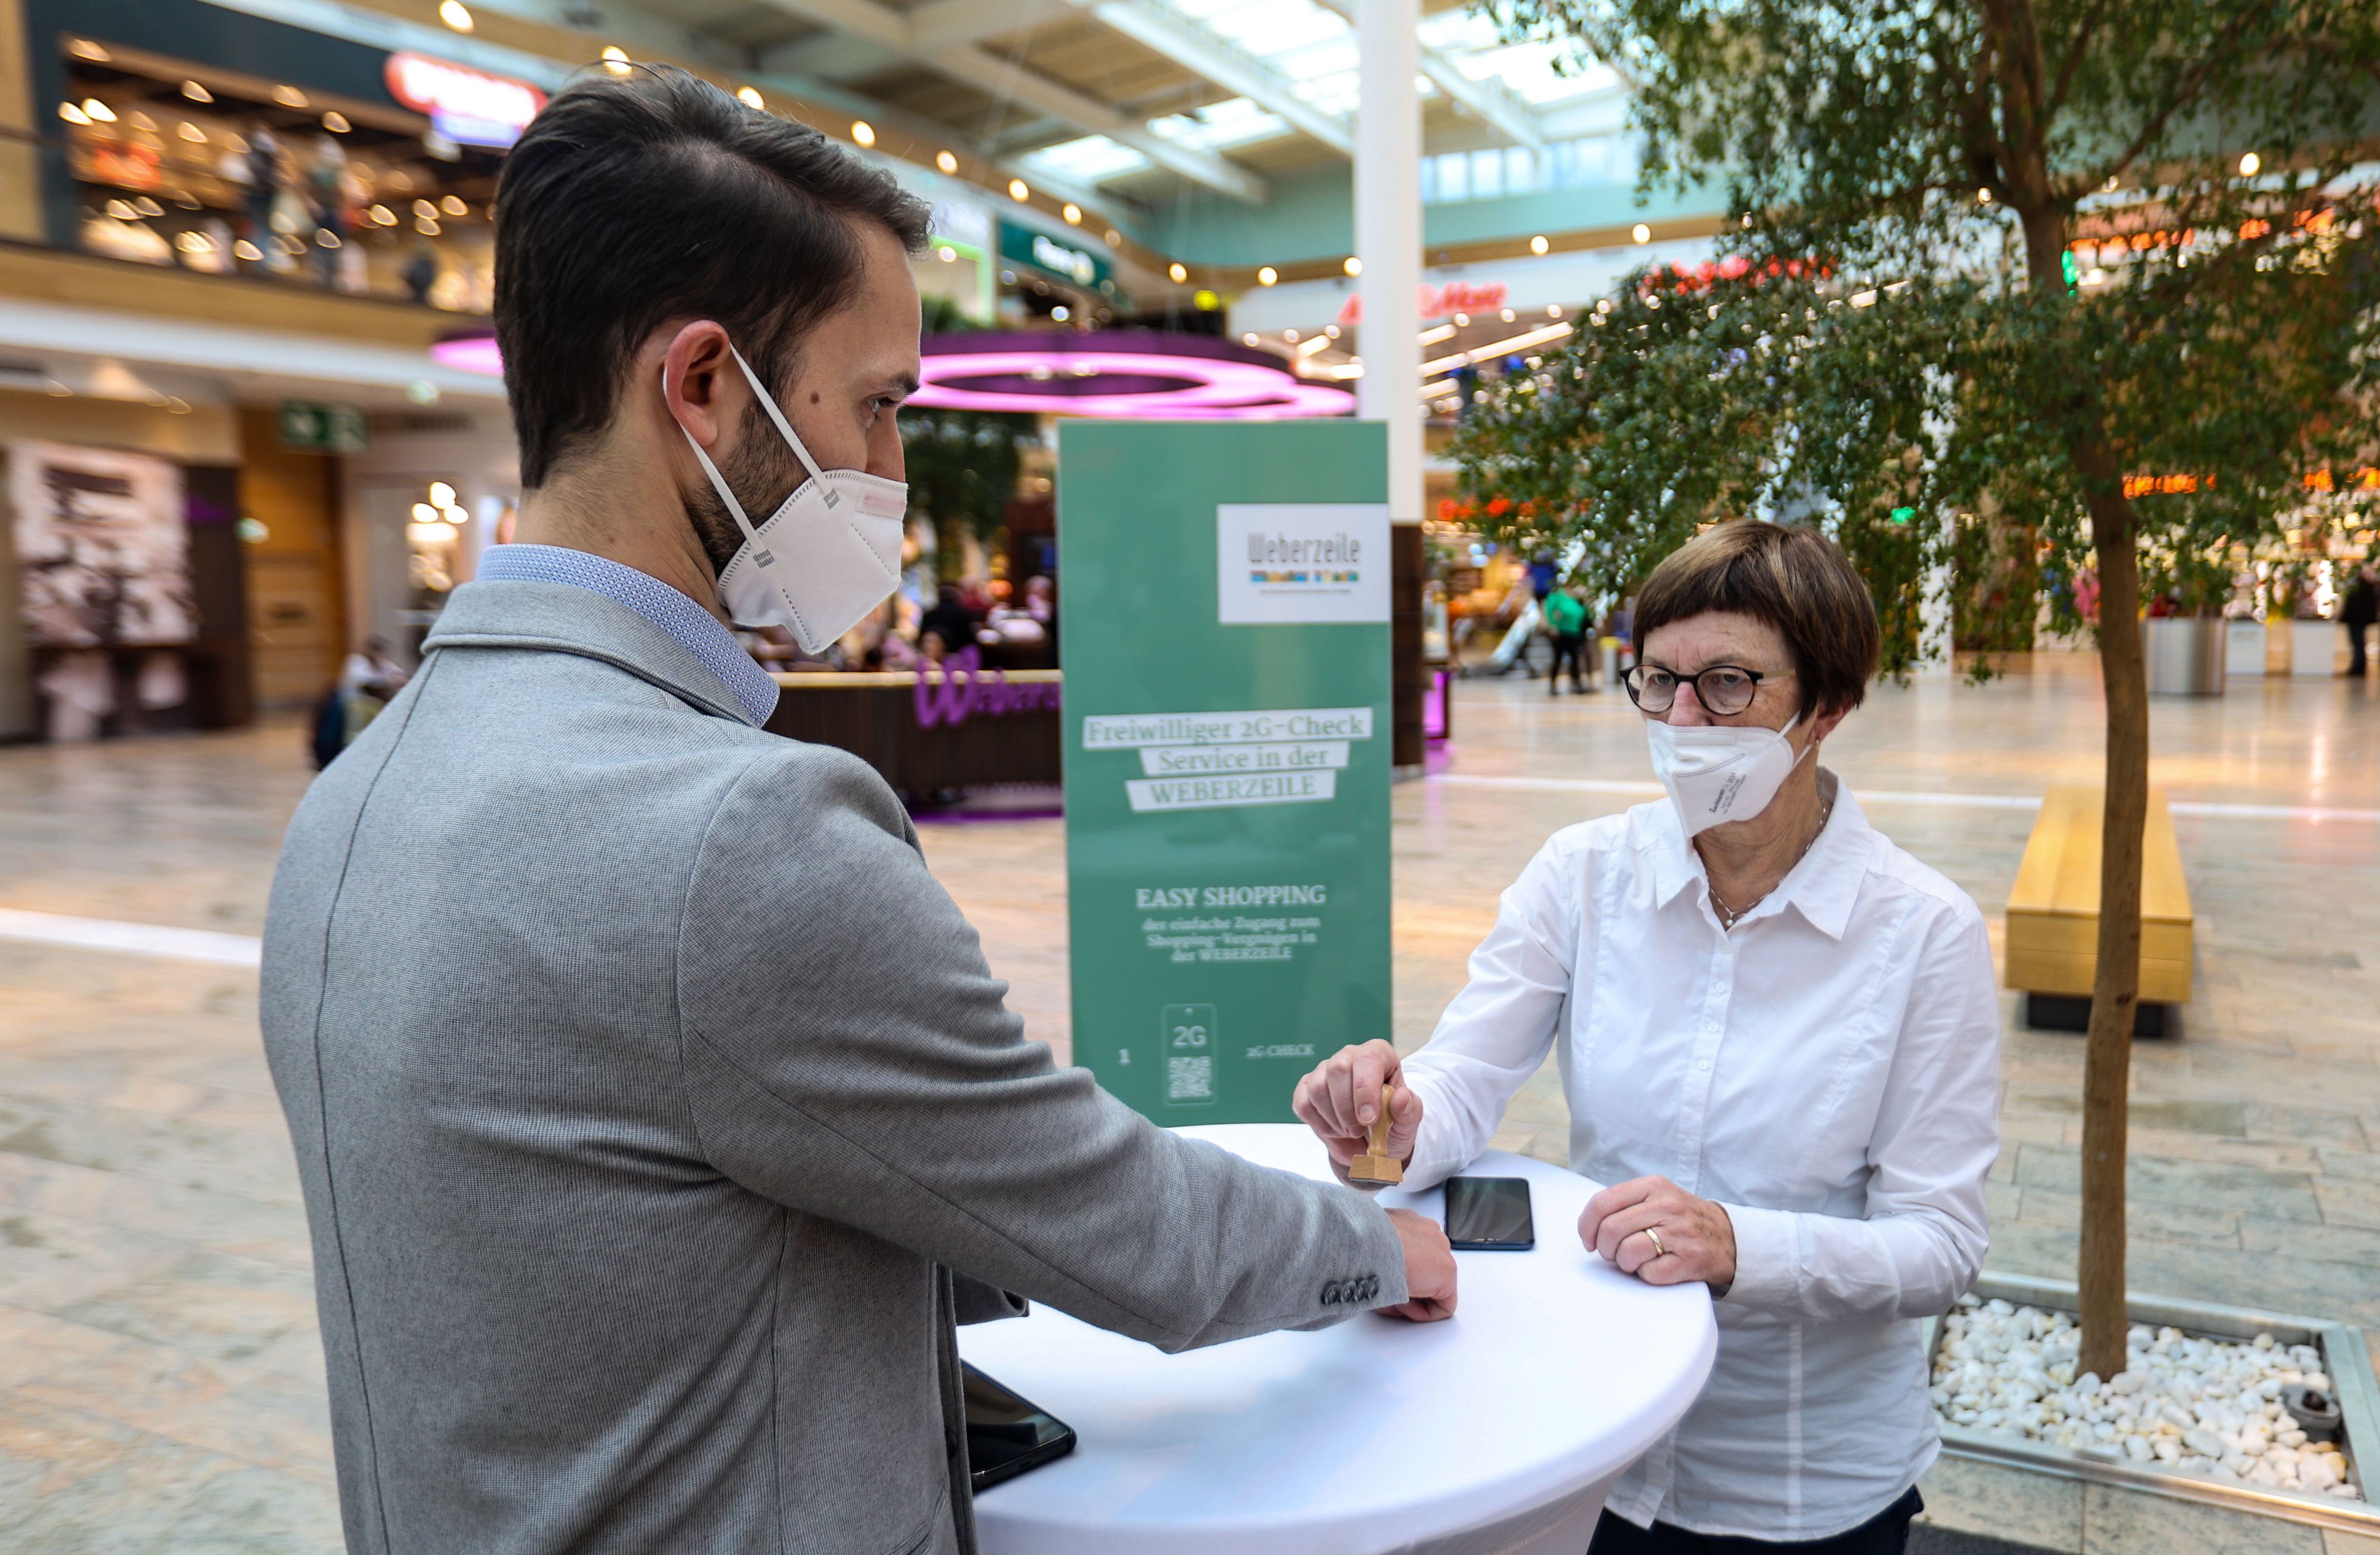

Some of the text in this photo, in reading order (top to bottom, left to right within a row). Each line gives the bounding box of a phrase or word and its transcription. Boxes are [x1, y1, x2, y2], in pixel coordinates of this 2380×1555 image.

[1248, 532, 1361, 563] Weberzeile
[1089, 715, 1363, 746] Freiwilliger 2G-Check
[1159, 745, 1329, 770] Service in der
[1150, 775, 1316, 803] WEBERZEILE
[1136, 885, 1326, 908] EASY SHOPPING
[1234, 916, 1286, 931] Zugang
[1301, 930, 1316, 943] in
[1170, 946, 1293, 962] der WEBERZEILE
[1172, 1025, 1207, 1048] 2G
[1118, 1048, 1130, 1065] 1
[1267, 1043, 1315, 1057] CHECK
